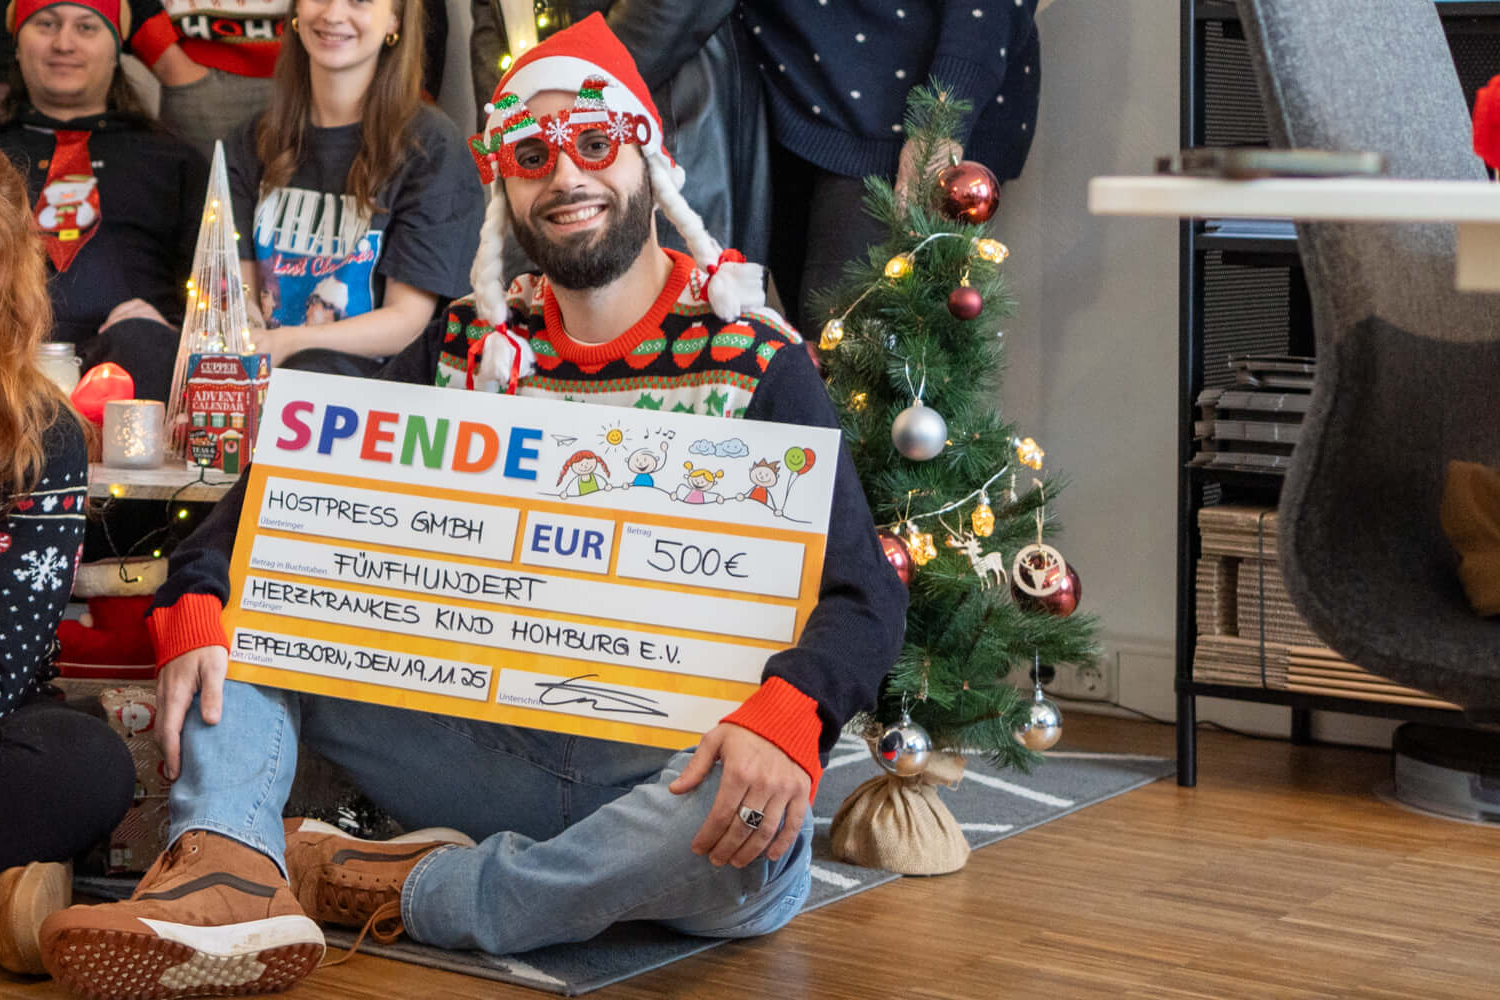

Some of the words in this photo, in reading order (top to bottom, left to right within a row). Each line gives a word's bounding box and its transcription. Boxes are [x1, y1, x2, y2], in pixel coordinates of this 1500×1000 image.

[273, 253, 308, 277] Last
[200, 362, 238, 370] CUPPER
[192, 391, 245, 402] ADVENT
[192, 400, 245, 411] CALENDAR
[275, 400, 544, 481] SPENDE
[260, 516, 305, 530] Überbringer
[267, 489, 399, 528] HOSTPRESS
[410, 510, 485, 545] GMBH
[626, 525, 652, 537] Betrag
[531, 523, 605, 561] EUR
[251, 557, 276, 569] Betrag
[276, 561, 284, 569] in
[285, 561, 328, 576] Buchstaben
[333, 551, 547, 602] FÜNFHUNDERT
[243, 598, 283, 612] Empfänger
[251, 579, 420, 624] HERZKRANKES
[435, 607, 494, 636] KIND
[511, 620, 630, 656] HOMBURG
[639, 640, 681, 664] E.V.
[236, 632, 352, 670] EPPELBORN,
[354, 650, 401, 674] DEN
